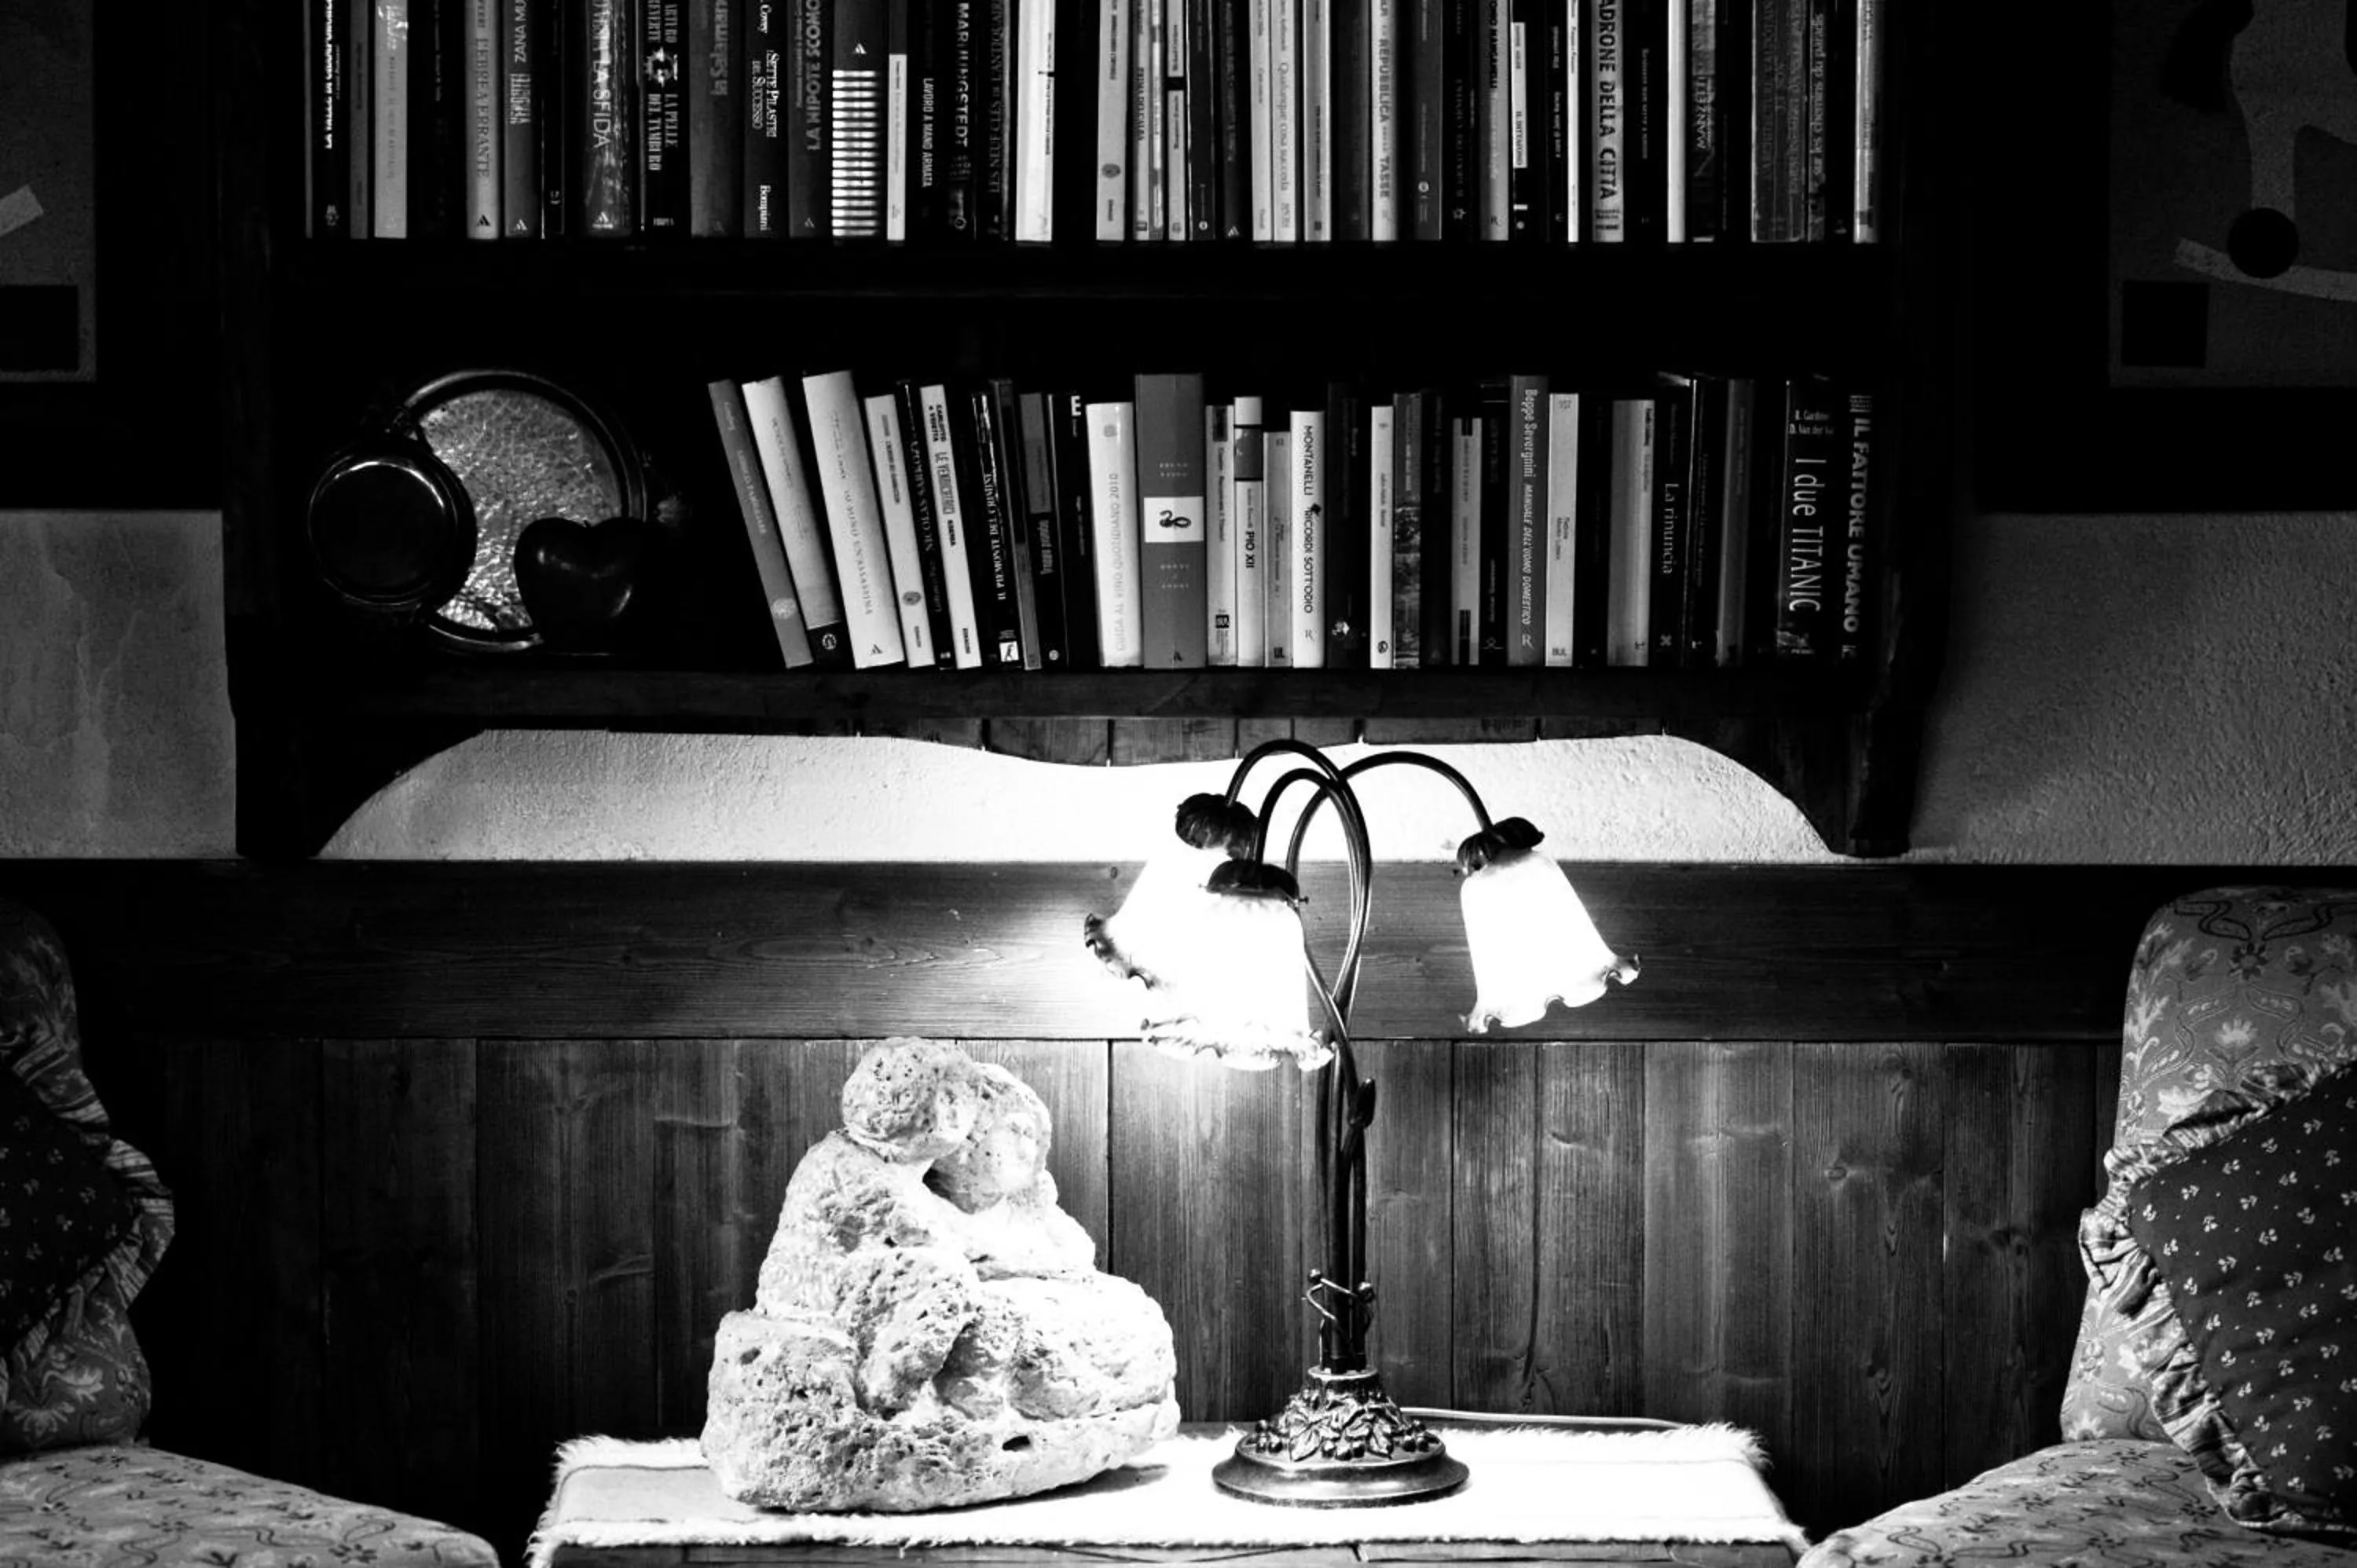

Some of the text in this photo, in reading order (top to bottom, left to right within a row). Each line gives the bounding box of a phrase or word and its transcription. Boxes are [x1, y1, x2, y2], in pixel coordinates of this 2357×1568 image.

[514, 24, 527, 63] ZANA
[757, 4, 772, 35] Covey
[647, 93, 662, 116] DEL
[751, 77, 765, 130] SUCCESSO
[806, 62, 822, 124] NIPOTE
[921, 78, 935, 113] LAVORO
[1277, 62, 1290, 121] Qualunque
[1378, 38, 1390, 123] REPUBBLICA
[593, 90, 611, 148] SFIDA
[1599, 81, 1616, 137] DELLA
[476, 106, 491, 178] ERRANTE
[806, 128, 822, 151] LA
[922, 123, 934, 150] MANO
[921, 152, 934, 188] ARMATA
[1378, 156, 1390, 198] TASSE
[757, 184, 772, 232] Bompiani
[1523, 388, 1538, 422] Beppe
[1521, 423, 1538, 478] Severgnini
[1109, 473, 1120, 500] 2010
[1791, 473, 1826, 517] due
[1245, 530, 1255, 551] PIO
[1303, 425, 1315, 614] MONTANELLI RICORDI SOTT'ODIO
[1661, 482, 1681, 576] La rinuncia
[1842, 417, 1871, 633] IL FATTORE UMANO
[989, 537, 1006, 588] PIEMONTE
[1245, 553, 1255, 569] XII
[1788, 526, 1824, 613] TITANIC
[1521, 575, 1534, 625] DOMESTICO
